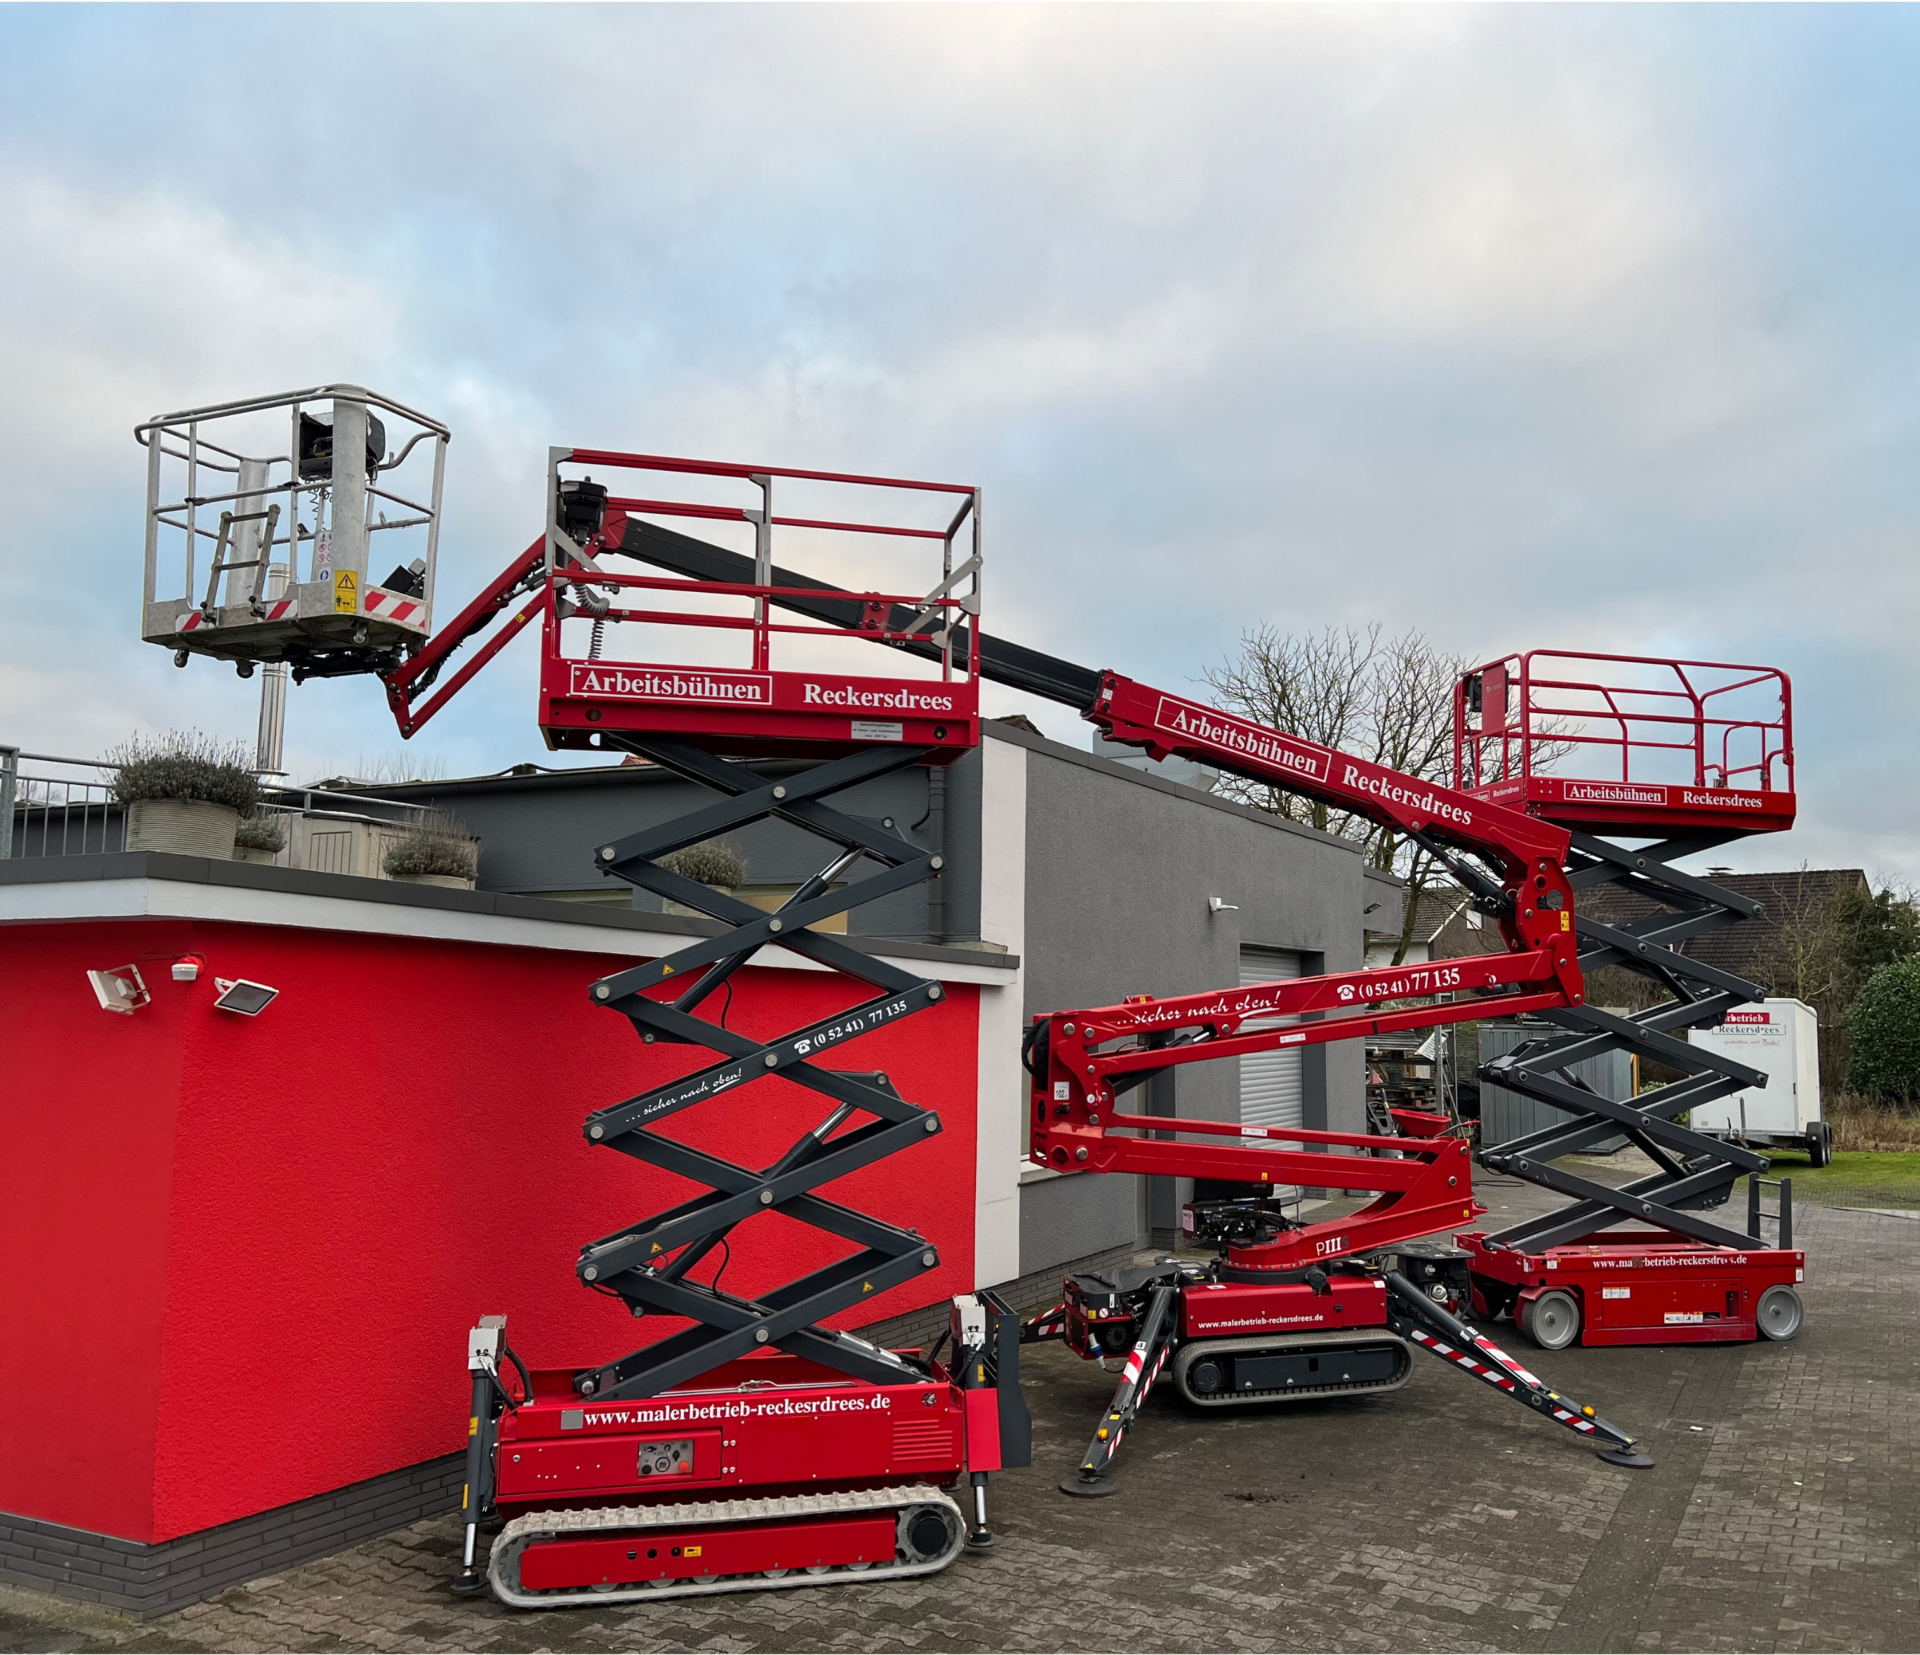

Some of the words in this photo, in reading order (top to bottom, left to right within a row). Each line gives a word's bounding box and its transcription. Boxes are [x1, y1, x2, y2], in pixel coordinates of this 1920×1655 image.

[582, 670, 761, 700] Arbeitsbühnen
[803, 683, 952, 711] Reckersdrees
[1171, 709, 1317, 774] Arbeitsbühnen
[1341, 764, 1472, 825] Reckersdrees
[1570, 785, 1662, 802] Arbeitsbühnen
[1683, 791, 1762, 807] Reckersdrees
[1411, 972, 1429, 990] 77
[1433, 968, 1460, 987] 135
[828, 1026, 843, 1040] 52
[845, 1018, 864, 1033] 41)
[868, 1009, 882, 1023] 77
[885, 1000, 907, 1016] 135
[1187, 997, 1229, 1017] nach
[1725, 1013, 1764, 1022] rbetrieb
[643, 1098, 677, 1115] sicher
[680, 1081, 709, 1101] nach
[713, 1068, 741, 1088] oben!
[1198, 1313, 1324, 1329] www.malerbetrieb-reckersdrees.de
[584, 1393, 891, 1426] www.malerbetrieb-reckesrdrees.de
